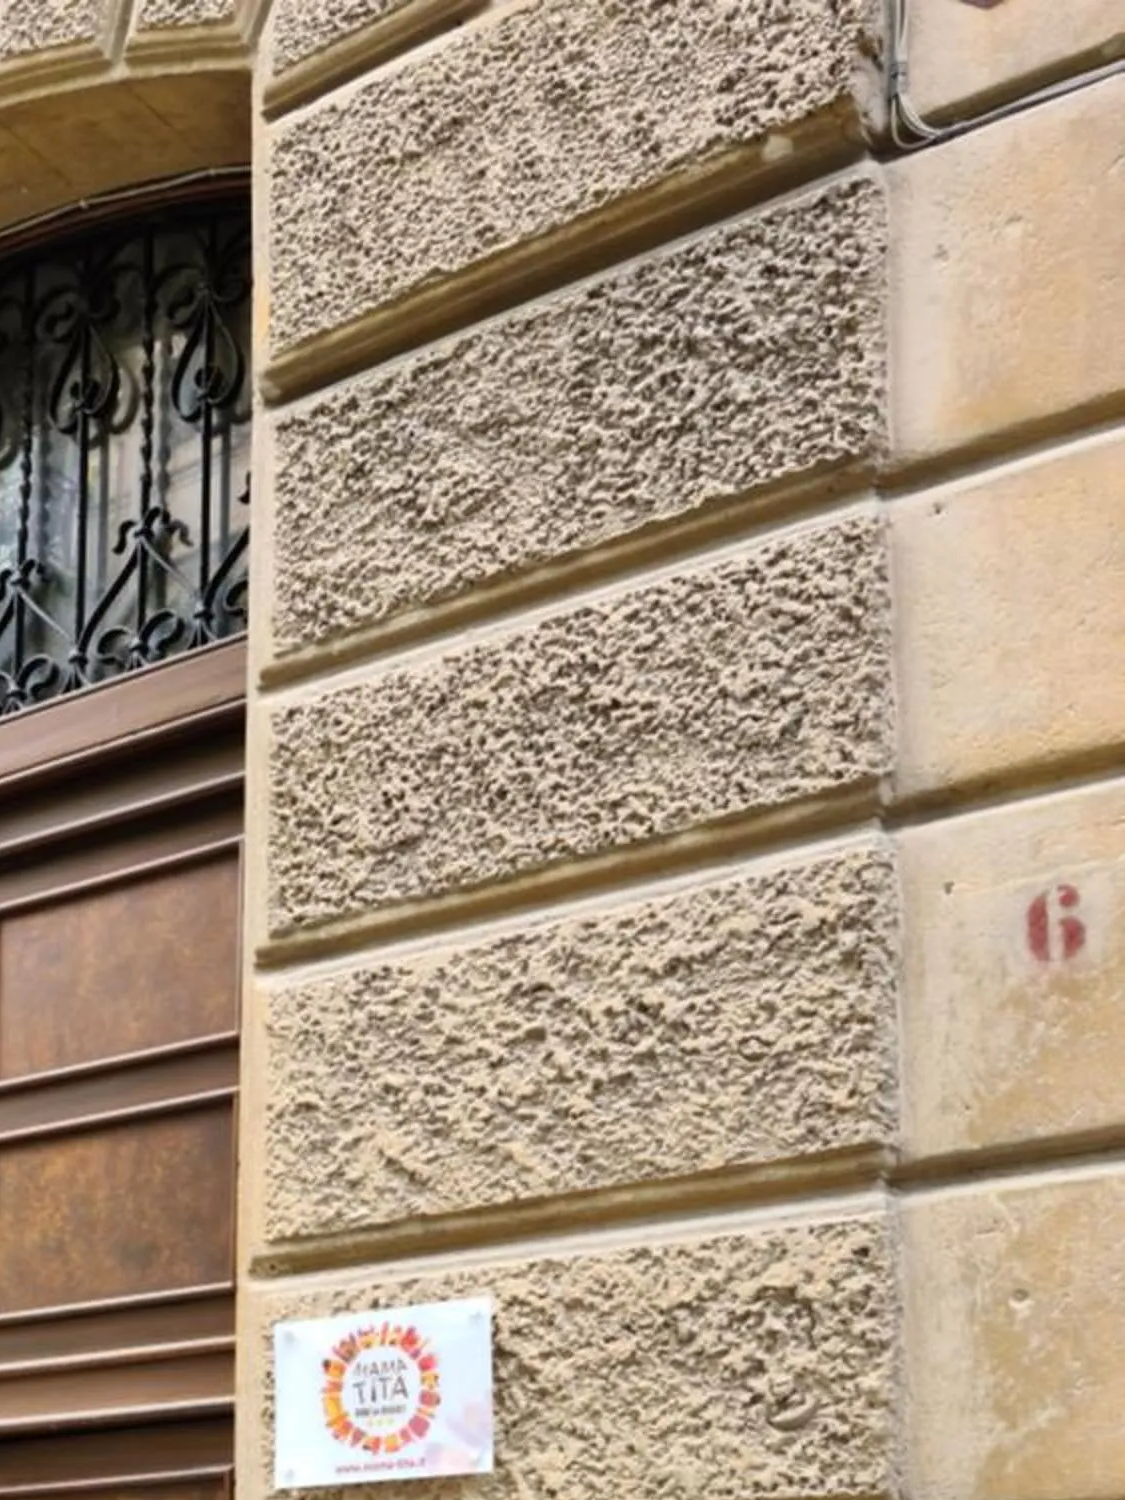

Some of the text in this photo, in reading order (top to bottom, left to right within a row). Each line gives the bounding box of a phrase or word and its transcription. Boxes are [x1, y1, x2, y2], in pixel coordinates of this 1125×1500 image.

[1025, 884, 1087, 963] 6
[353, 1359, 408, 1376] MAMA
[352, 1375, 409, 1405] TITA
